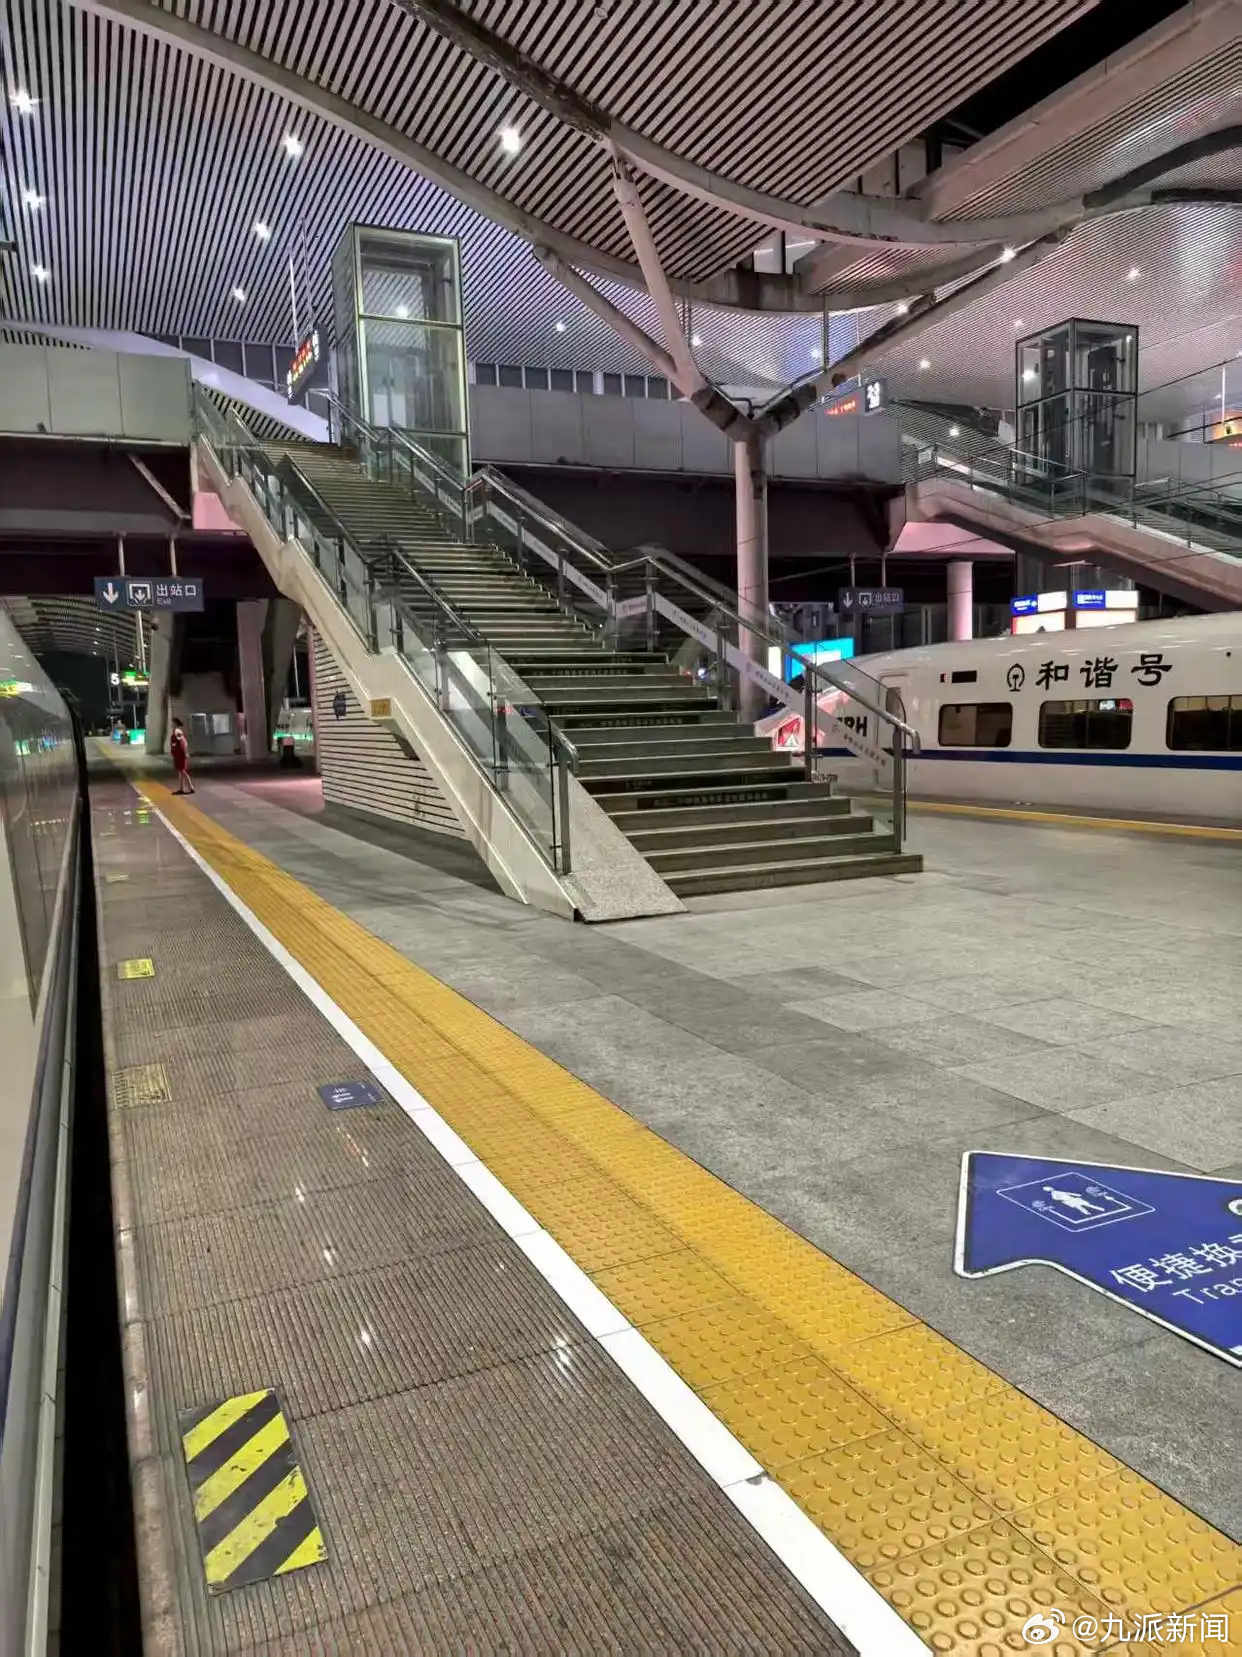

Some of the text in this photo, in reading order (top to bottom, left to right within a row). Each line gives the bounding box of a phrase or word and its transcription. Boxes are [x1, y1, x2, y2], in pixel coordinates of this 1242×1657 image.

[156, 584, 197, 597] 出站口
[110, 672, 120, 685] 5
[1035, 654, 1173, 690] 和谐号
